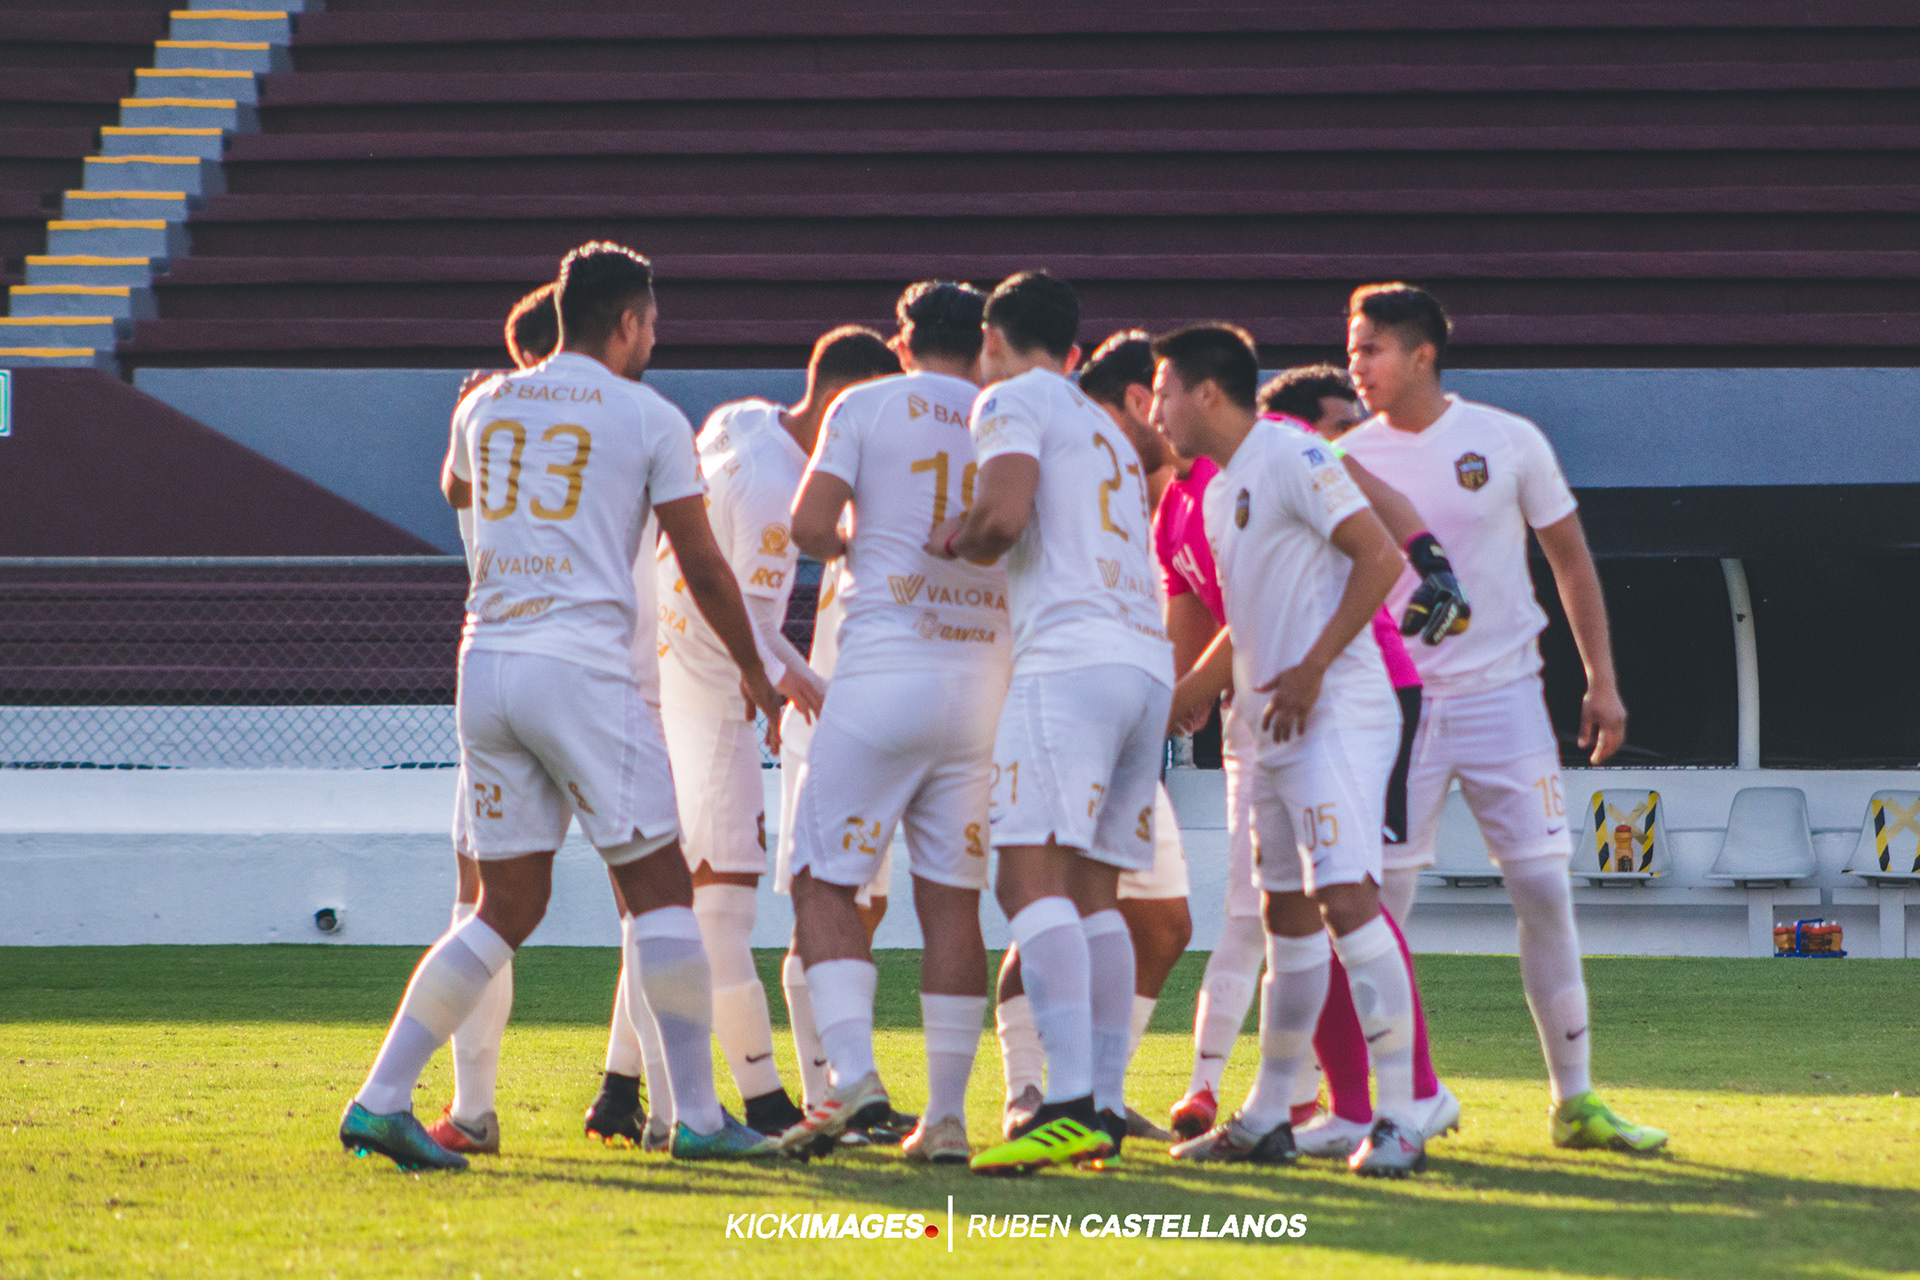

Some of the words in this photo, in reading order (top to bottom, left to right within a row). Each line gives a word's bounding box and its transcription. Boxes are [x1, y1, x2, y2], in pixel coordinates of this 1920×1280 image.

[517, 382, 603, 405] BACUA
[479, 418, 592, 522] 03
[496, 555, 573, 576] VALORA
[926, 584, 1008, 611] VALORA
[1303, 802, 1339, 851] 05
